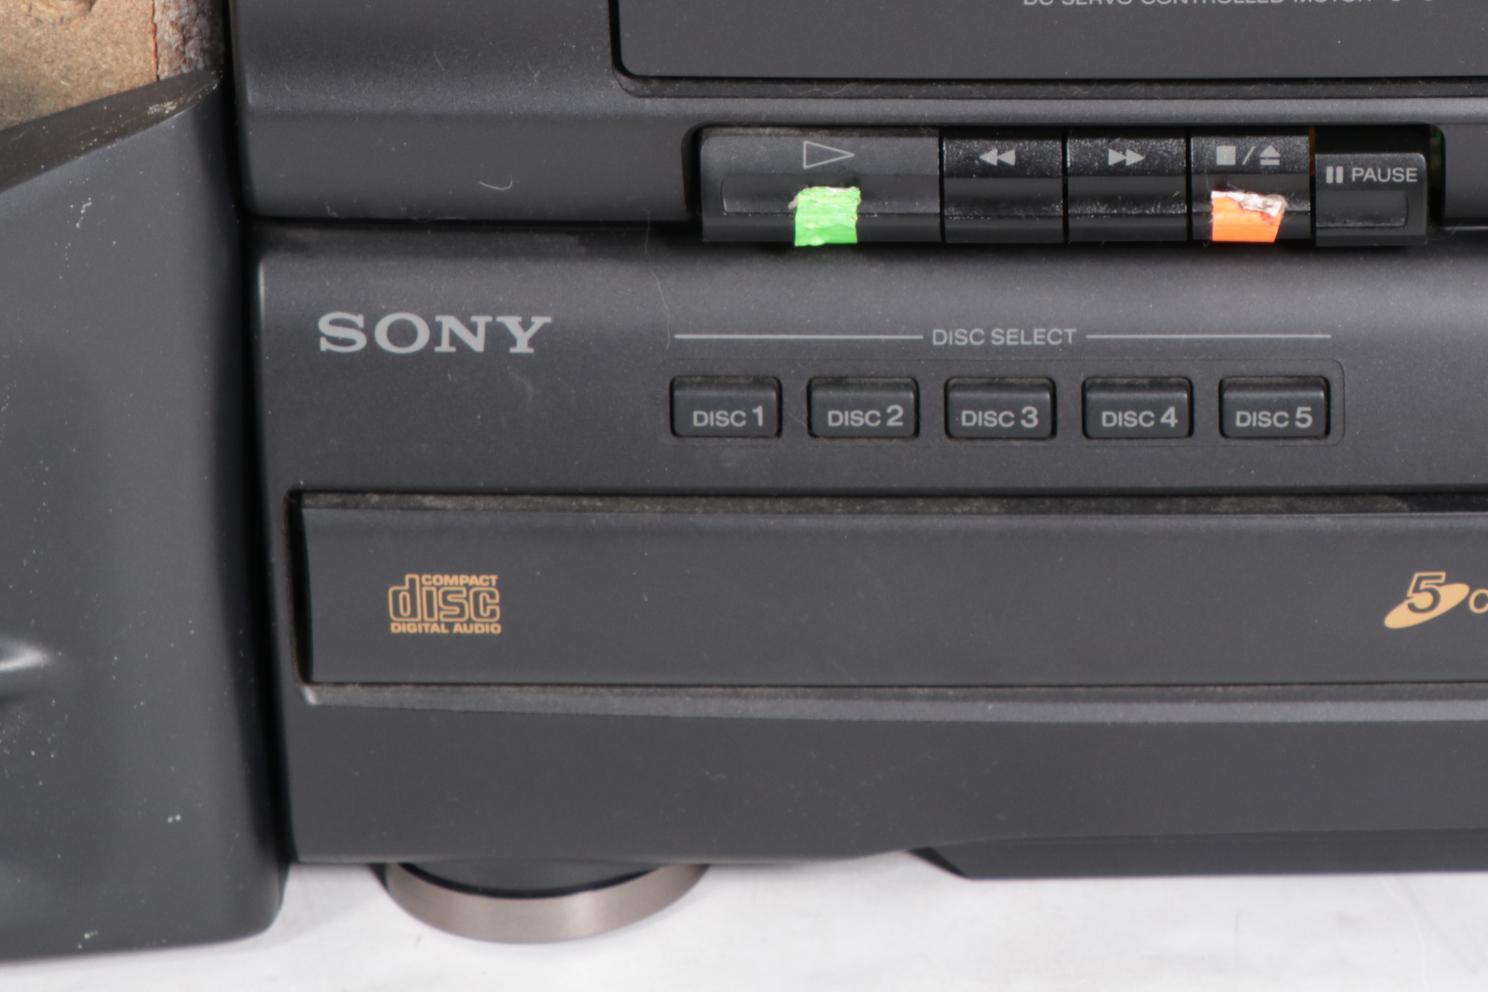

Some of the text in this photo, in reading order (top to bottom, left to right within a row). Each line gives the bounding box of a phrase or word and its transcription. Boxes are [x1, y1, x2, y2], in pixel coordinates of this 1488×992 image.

[1351, 167, 1418, 183] PAUSE
[318, 312, 552, 354] SONY
[932, 328, 1077, 346] DISC SELECT
[693, 406, 764, 427] DISC 1
[827, 405, 904, 427] DISC 2
[961, 406, 1039, 428] DISC 3
[1101, 406, 1178, 428] DISC 4
[1236, 406, 1313, 428] DISC 5
[421, 574, 498, 586] COMPACT
[391, 623, 501, 634] DIGITAL AUDIO
